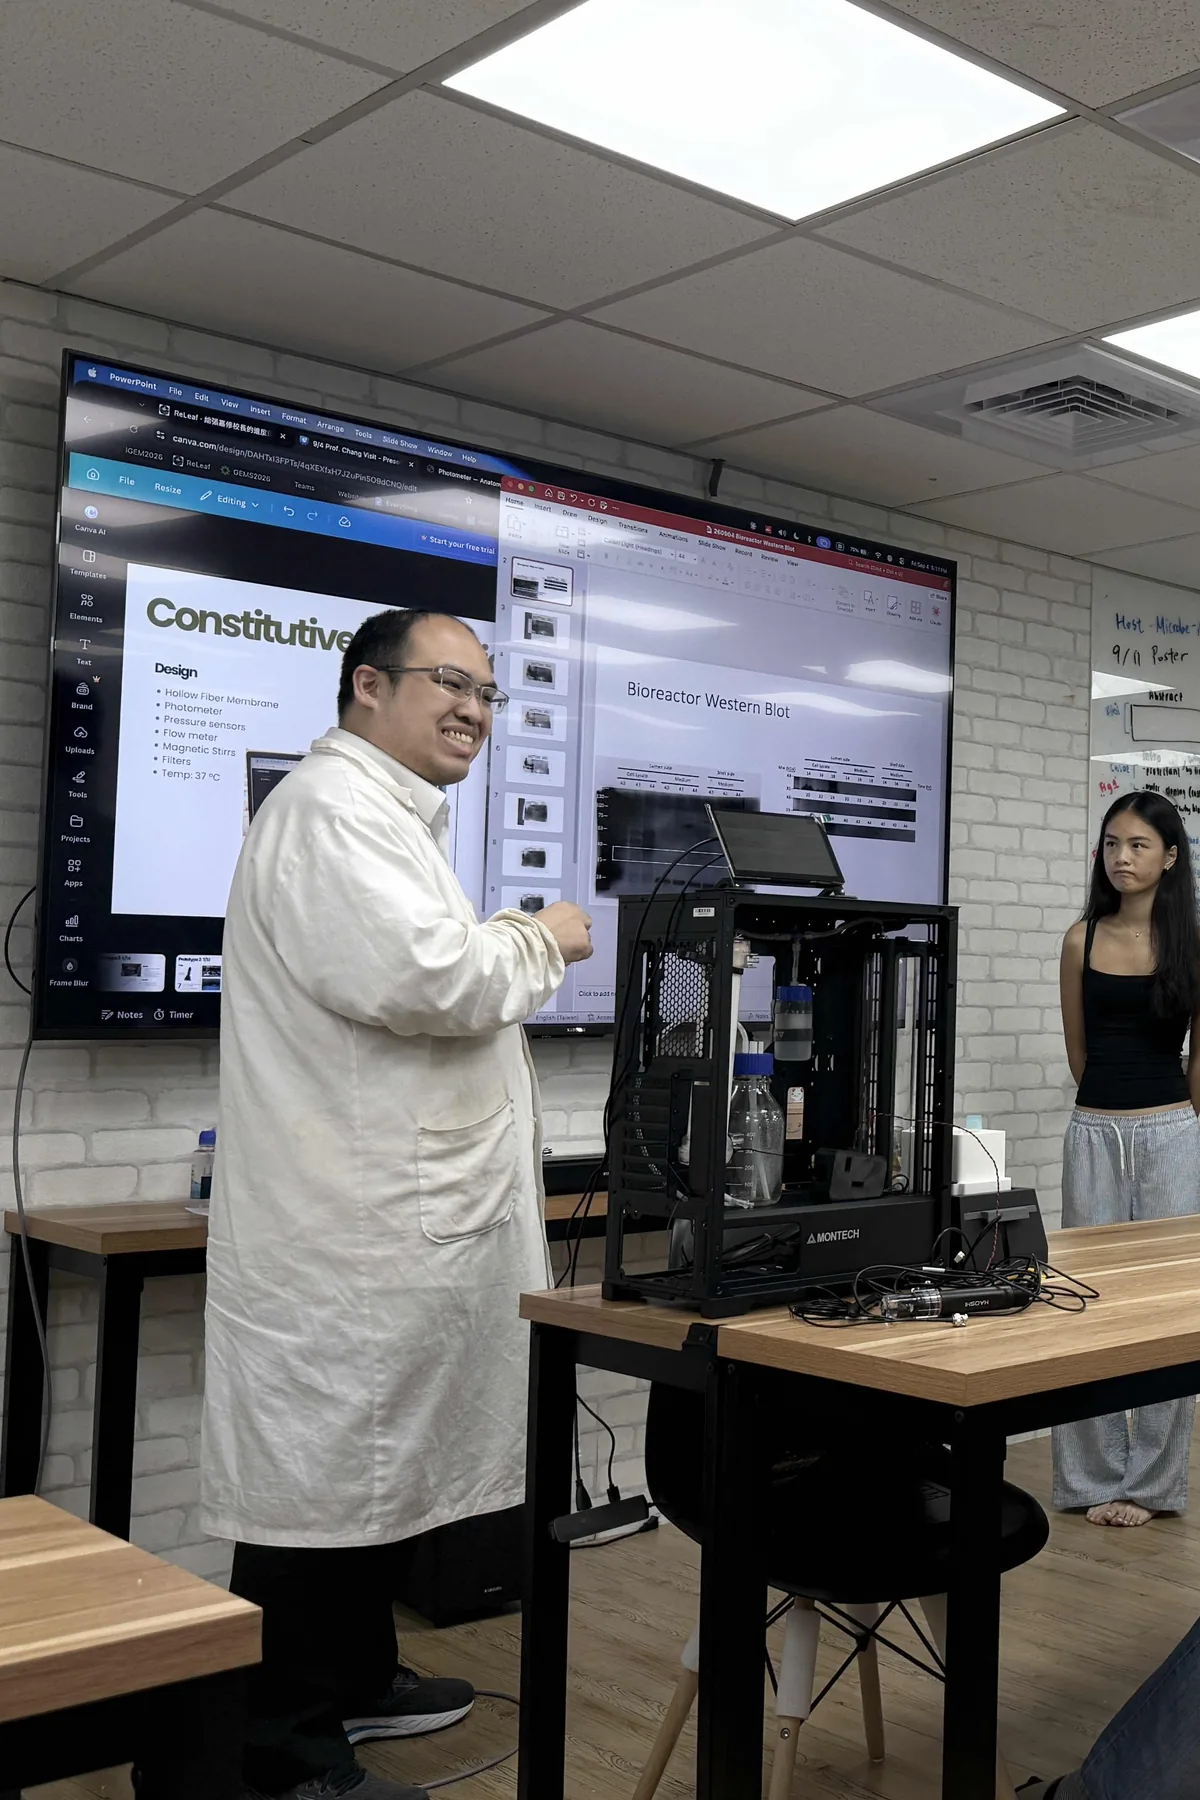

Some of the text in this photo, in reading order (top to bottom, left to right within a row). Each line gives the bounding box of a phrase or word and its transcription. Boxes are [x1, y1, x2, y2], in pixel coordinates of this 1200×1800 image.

[110, 372, 477, 464] PowerPoint File Edit View Insert Format Arrange Tools Slide Show Window Help
[173, 409, 199, 421] ReLeaf
[312, 440, 377, 461] 9/4 Prof. Chang Visit
[186, 460, 211, 470] ReLeaf
[233, 469, 271, 483] GEMS2026
[438, 468, 472, 481] Photometer
[119, 476, 135, 487] File
[294, 481, 315, 491] Teams
[154, 482, 182, 495] Resize
[217, 494, 247, 509] Editing
[75, 524, 106, 536] Canva AI
[505, 497, 524, 507] Home
[534, 503, 552, 513] Insert
[588, 515, 608, 525] Design
[619, 522, 648, 534] Transitions
[659, 531, 689, 543] Animations
[698, 539, 711, 549] Slide
[712, 542, 726, 551] Show
[735, 548, 753, 558] Record
[761, 553, 779, 564] Review
[787, 559, 799, 567] View
[429, 536, 495, 556] Start your free trial
[763, 540, 784, 550] Western
[784, 544, 795, 553] Blot
[70, 568, 107, 580] Templates
[69, 613, 103, 624] Elements
[1116, 613, 1145, 634] Host
[146, 597, 355, 653] Constitutive
[77, 658, 92, 666] Text
[1113, 645, 1188, 667] 9/11 Poster
[154, 662, 198, 680] Design
[165, 688, 279, 709] Hollow Fiber Membrane
[627, 681, 790, 719] Bioreactor Western Blot
[1149, 691, 1183, 702] Abstract
[71, 702, 93, 711] Brand
[164, 702, 223, 716] Photometer
[164, 715, 246, 731] Pressure sensors
[163, 728, 218, 742] Flow meter
[65, 746, 95, 756] Uploads
[162, 742, 236, 756] Magnetic Stirrs
[162, 756, 191, 766] Filters
[162, 769, 193, 781] Temp:
[195, 771, 207, 780] 37
[68, 790, 88, 799] Tools
[61, 835, 91, 844] Projects
[64, 879, 83, 888] Apps
[59, 934, 83, 942] Charts
[49, 979, 89, 987] Frame Blur
[117, 1011, 144, 1019] Notes
[169, 1010, 194, 1019] Timer
[556, 1014, 579, 1022] (Taiwan)
[817, 1228, 860, 1243] MONTECH
